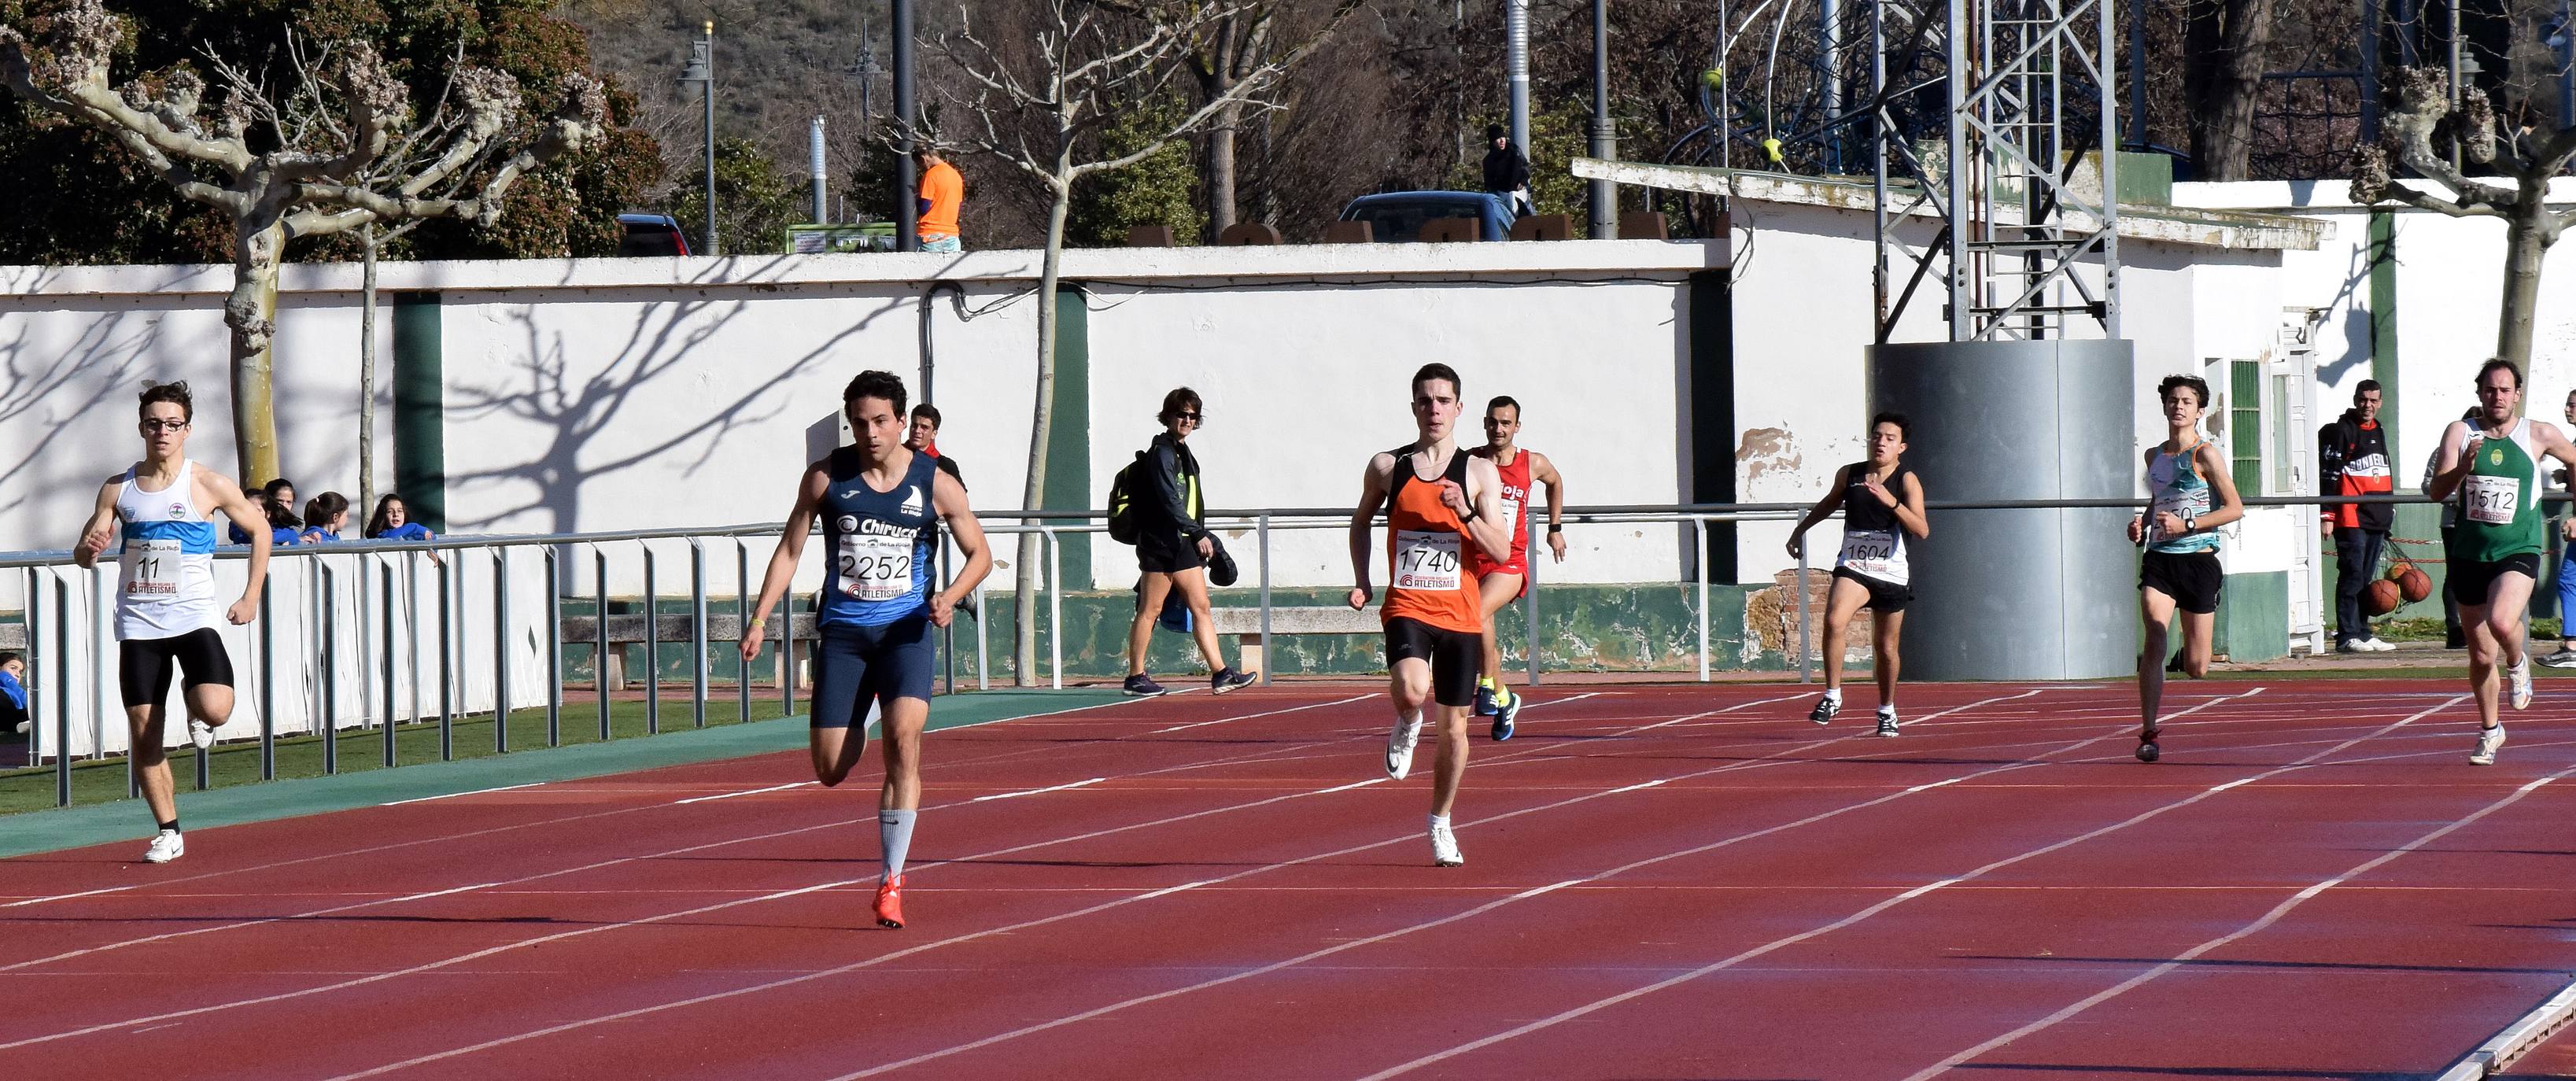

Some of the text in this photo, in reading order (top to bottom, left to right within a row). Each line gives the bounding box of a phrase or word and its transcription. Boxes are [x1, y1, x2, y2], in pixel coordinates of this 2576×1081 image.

[1501, 482, 1524, 500] ioja
[2469, 489, 2515, 510] 1512
[861, 518, 917, 539] Chiruca
[1401, 548, 1457, 572] 1740
[1848, 544, 1889, 560] 1604
[138, 557, 159, 578] 11
[841, 555, 910, 580] 2252
[862, 588, 903, 598] ATLETISMO
[1415, 579, 1455, 588] ATLETISMO
